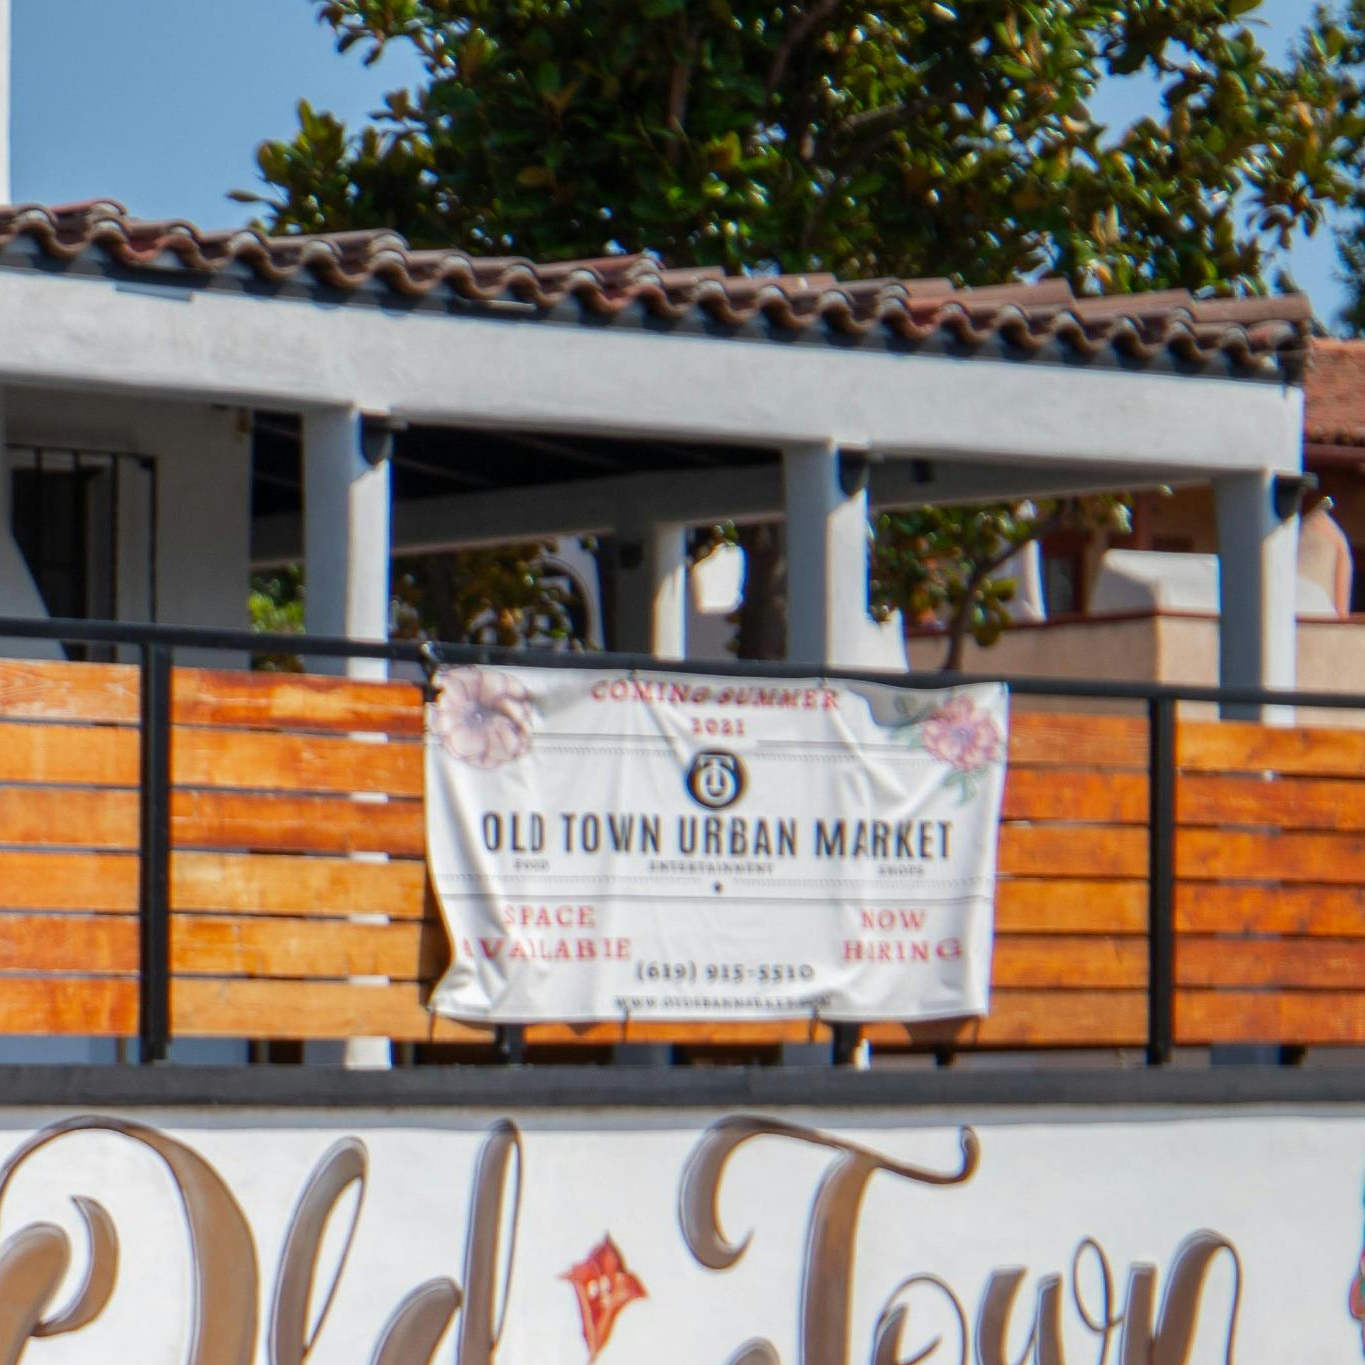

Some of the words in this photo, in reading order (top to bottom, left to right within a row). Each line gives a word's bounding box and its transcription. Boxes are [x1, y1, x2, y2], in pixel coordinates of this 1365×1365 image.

[590, 678, 710, 704] COMING
[718, 687, 839, 711] SUMMER
[482, 812, 545, 853] OLD
[561, 813, 661, 854] TOWN
[679, 815, 797, 856] URBAN
[815, 818, 953, 859] MARKET
[504, 904, 597, 928] SPACE
[860, 908, 926, 929] NOW
[842, 938, 962, 961] HIRING
[635, 960, 698, 981] (619)
